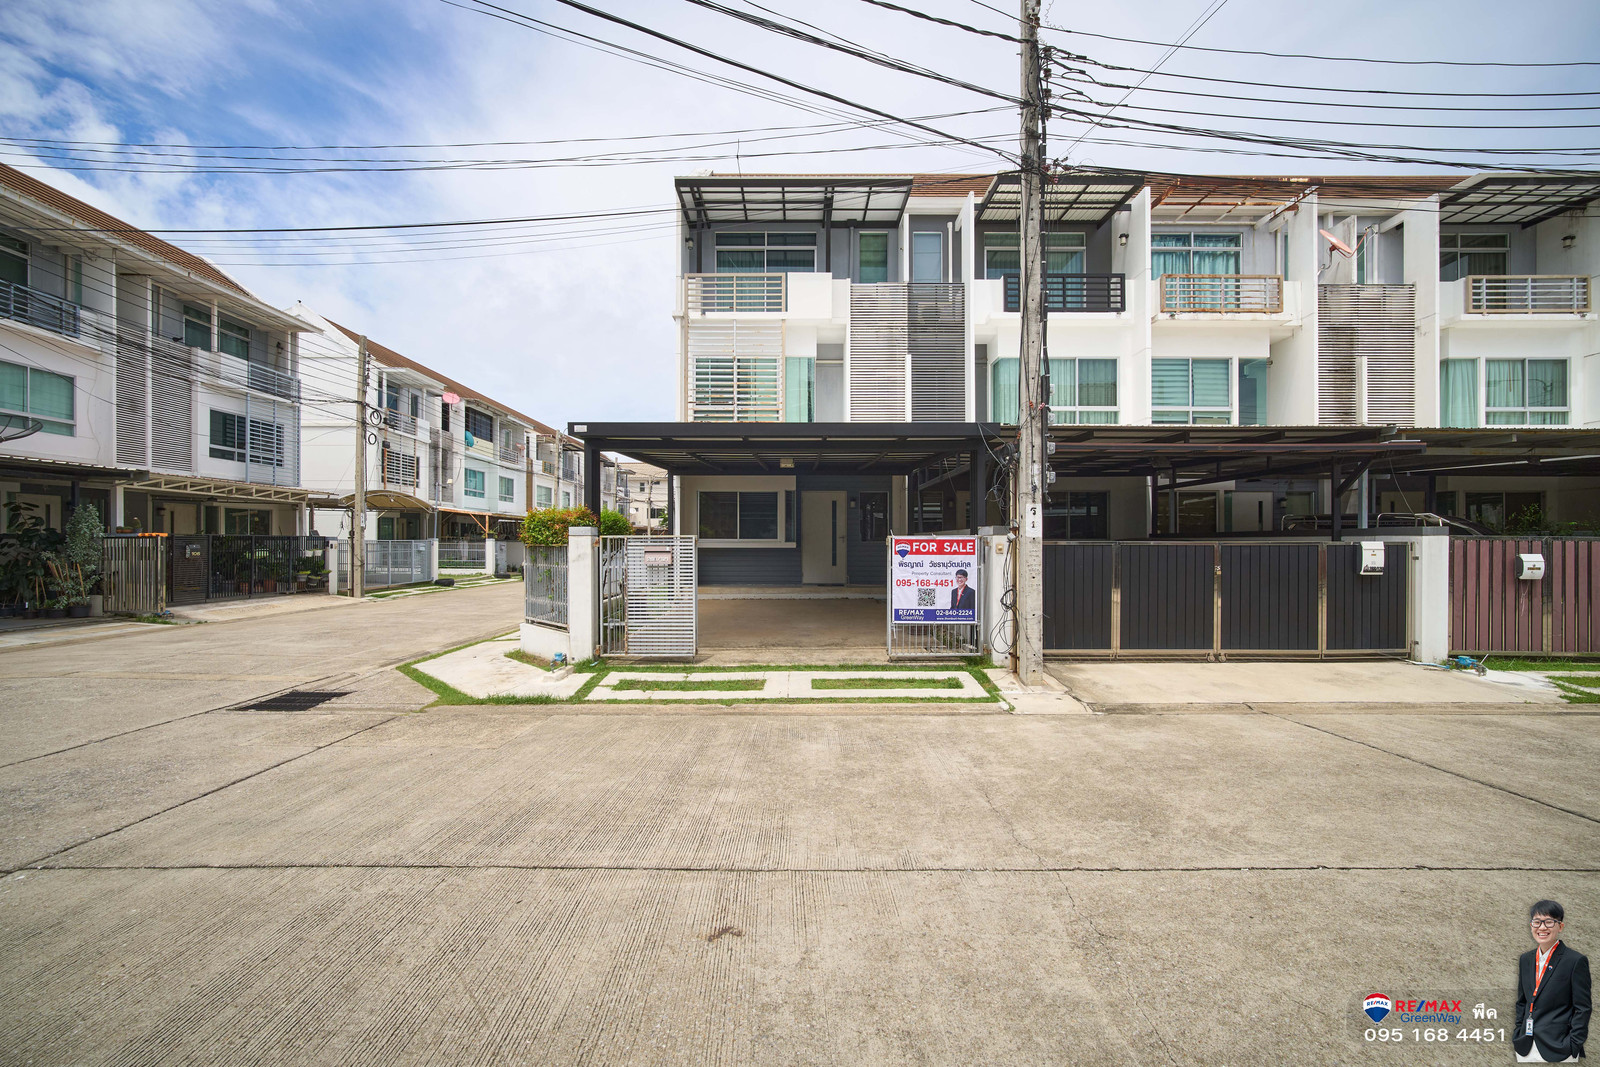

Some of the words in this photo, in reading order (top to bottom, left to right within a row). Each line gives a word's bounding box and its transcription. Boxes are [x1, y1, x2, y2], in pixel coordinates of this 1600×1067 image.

[912, 542, 937, 553] FOR
[943, 542, 974, 553] SALE
[896, 579, 954, 587] 095-168-4451
